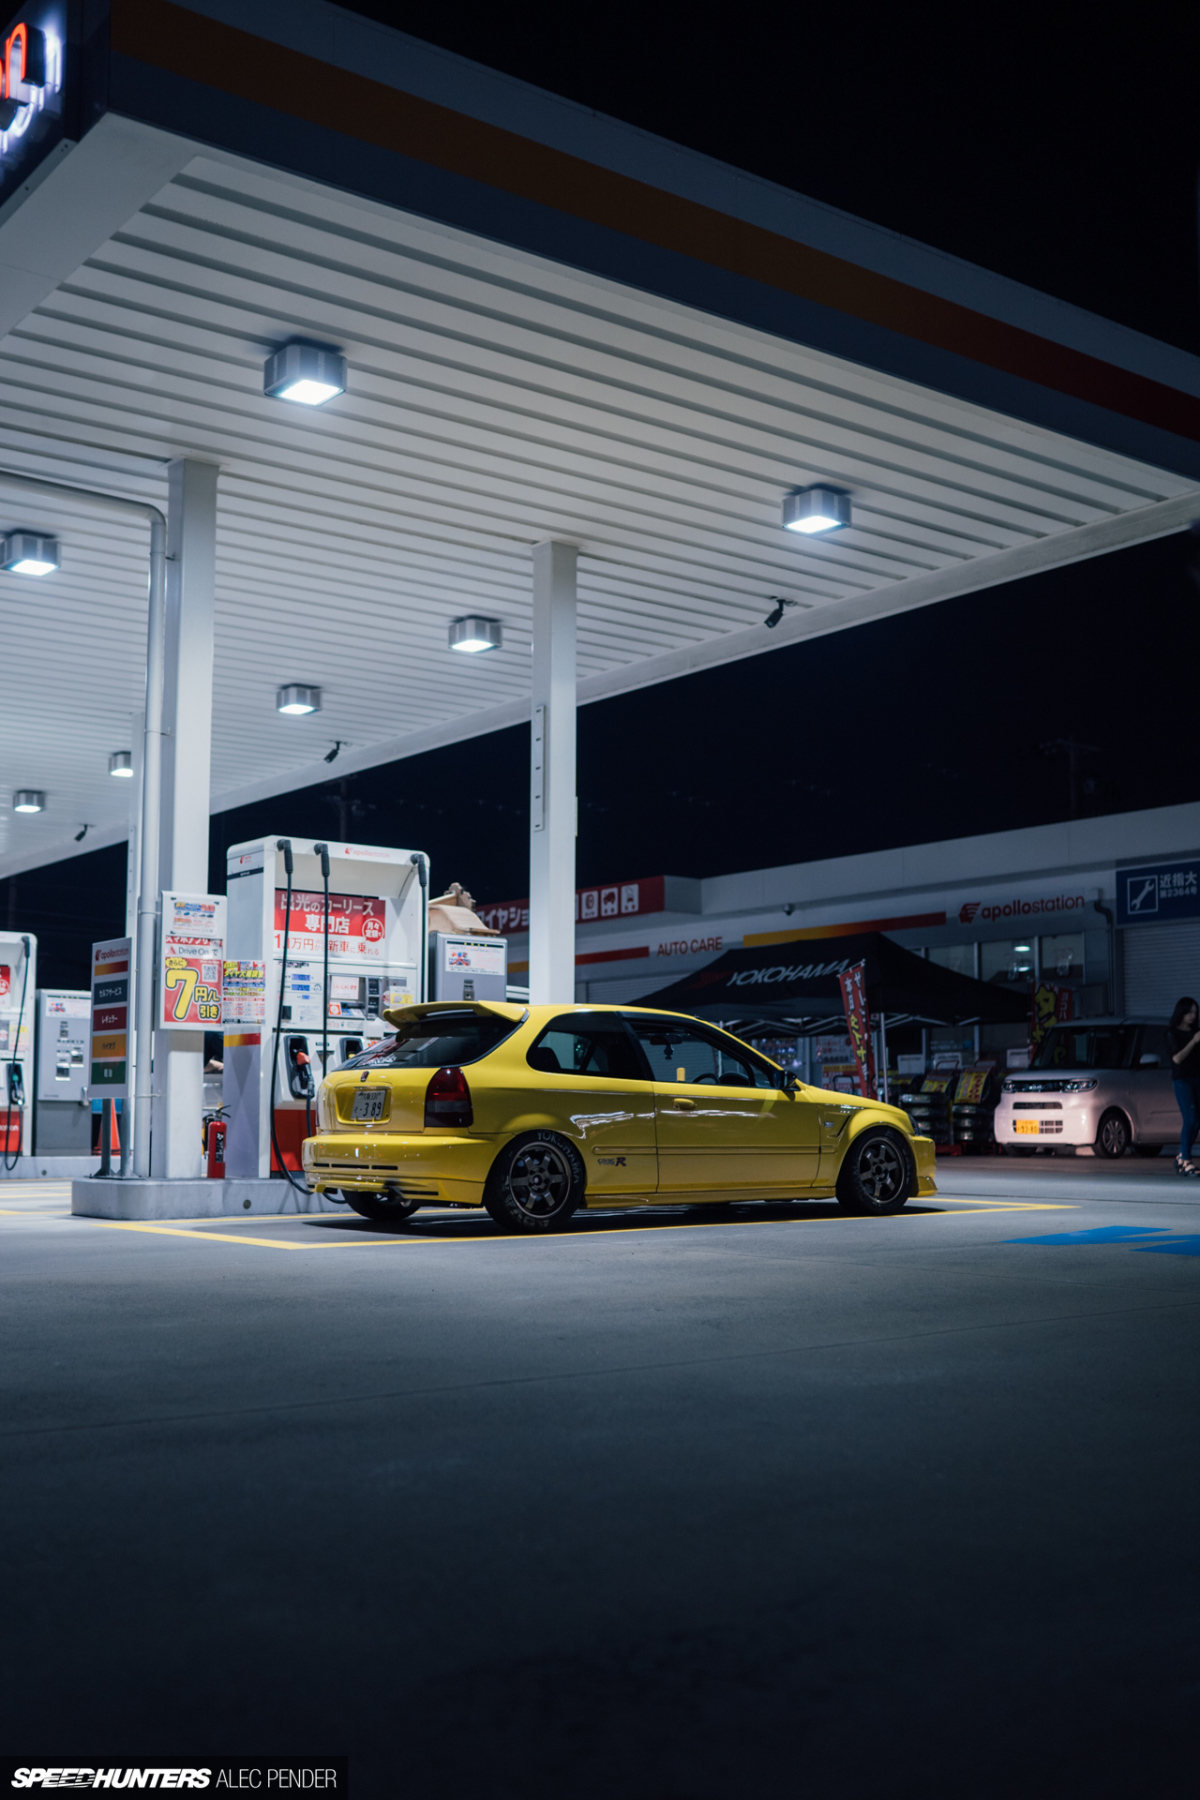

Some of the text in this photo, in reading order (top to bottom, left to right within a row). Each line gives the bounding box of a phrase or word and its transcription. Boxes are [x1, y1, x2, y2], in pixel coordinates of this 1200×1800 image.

[981, 895, 1085, 922] apollostation
[305, 914, 350, 934] 専門店
[178, 947, 197, 955] Drive
[657, 936, 723, 957] AUTO CARE
[726, 958, 850, 987] YOKOHAMA
[166, 968, 199, 1020] 7
[199, 1004, 220, 1019] 引き
